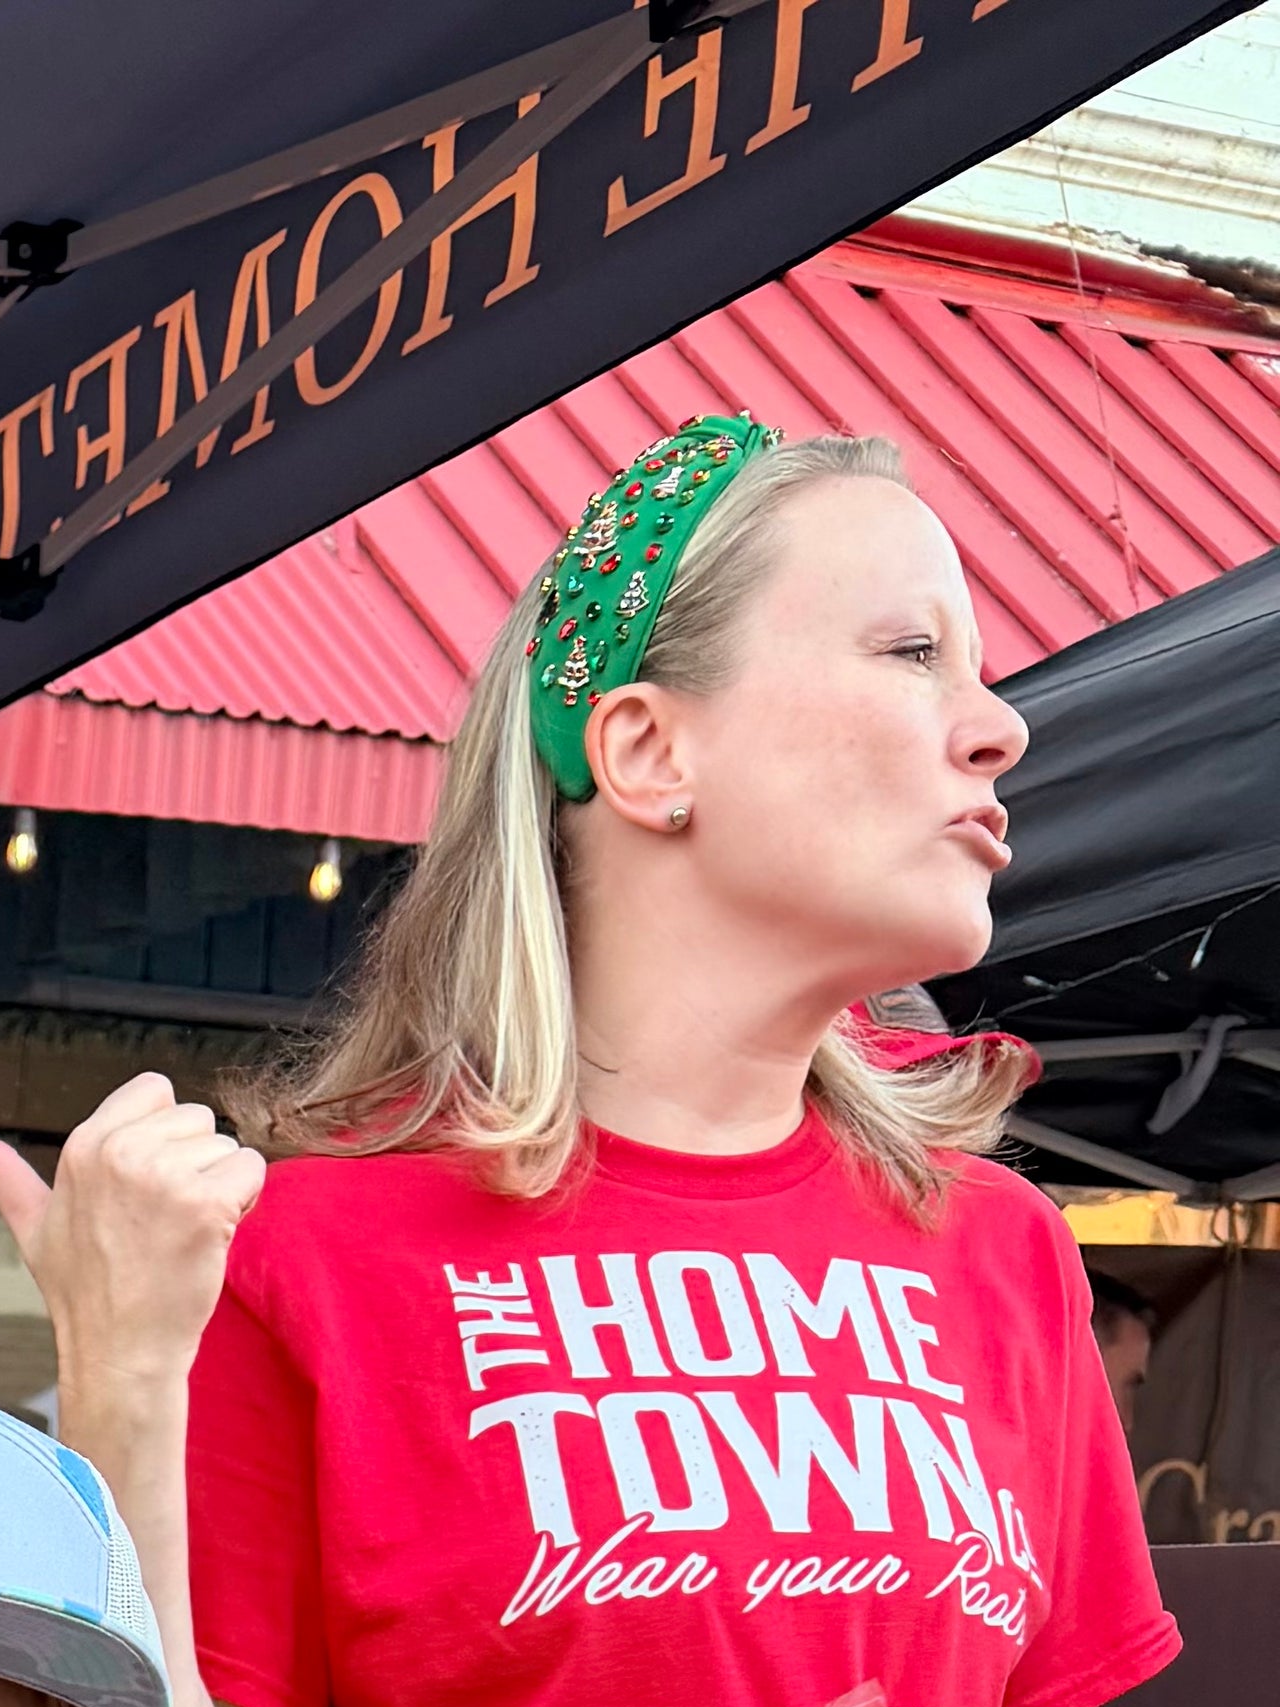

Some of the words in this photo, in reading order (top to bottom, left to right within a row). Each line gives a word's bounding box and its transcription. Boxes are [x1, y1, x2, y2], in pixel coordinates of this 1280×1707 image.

[443, 1261, 550, 1392] THE
[538, 1250, 964, 1404] HOME
[467, 1389, 1003, 1565] TOWN
[499, 1511, 719, 1628] Wear
[740, 1543, 911, 1615] your
